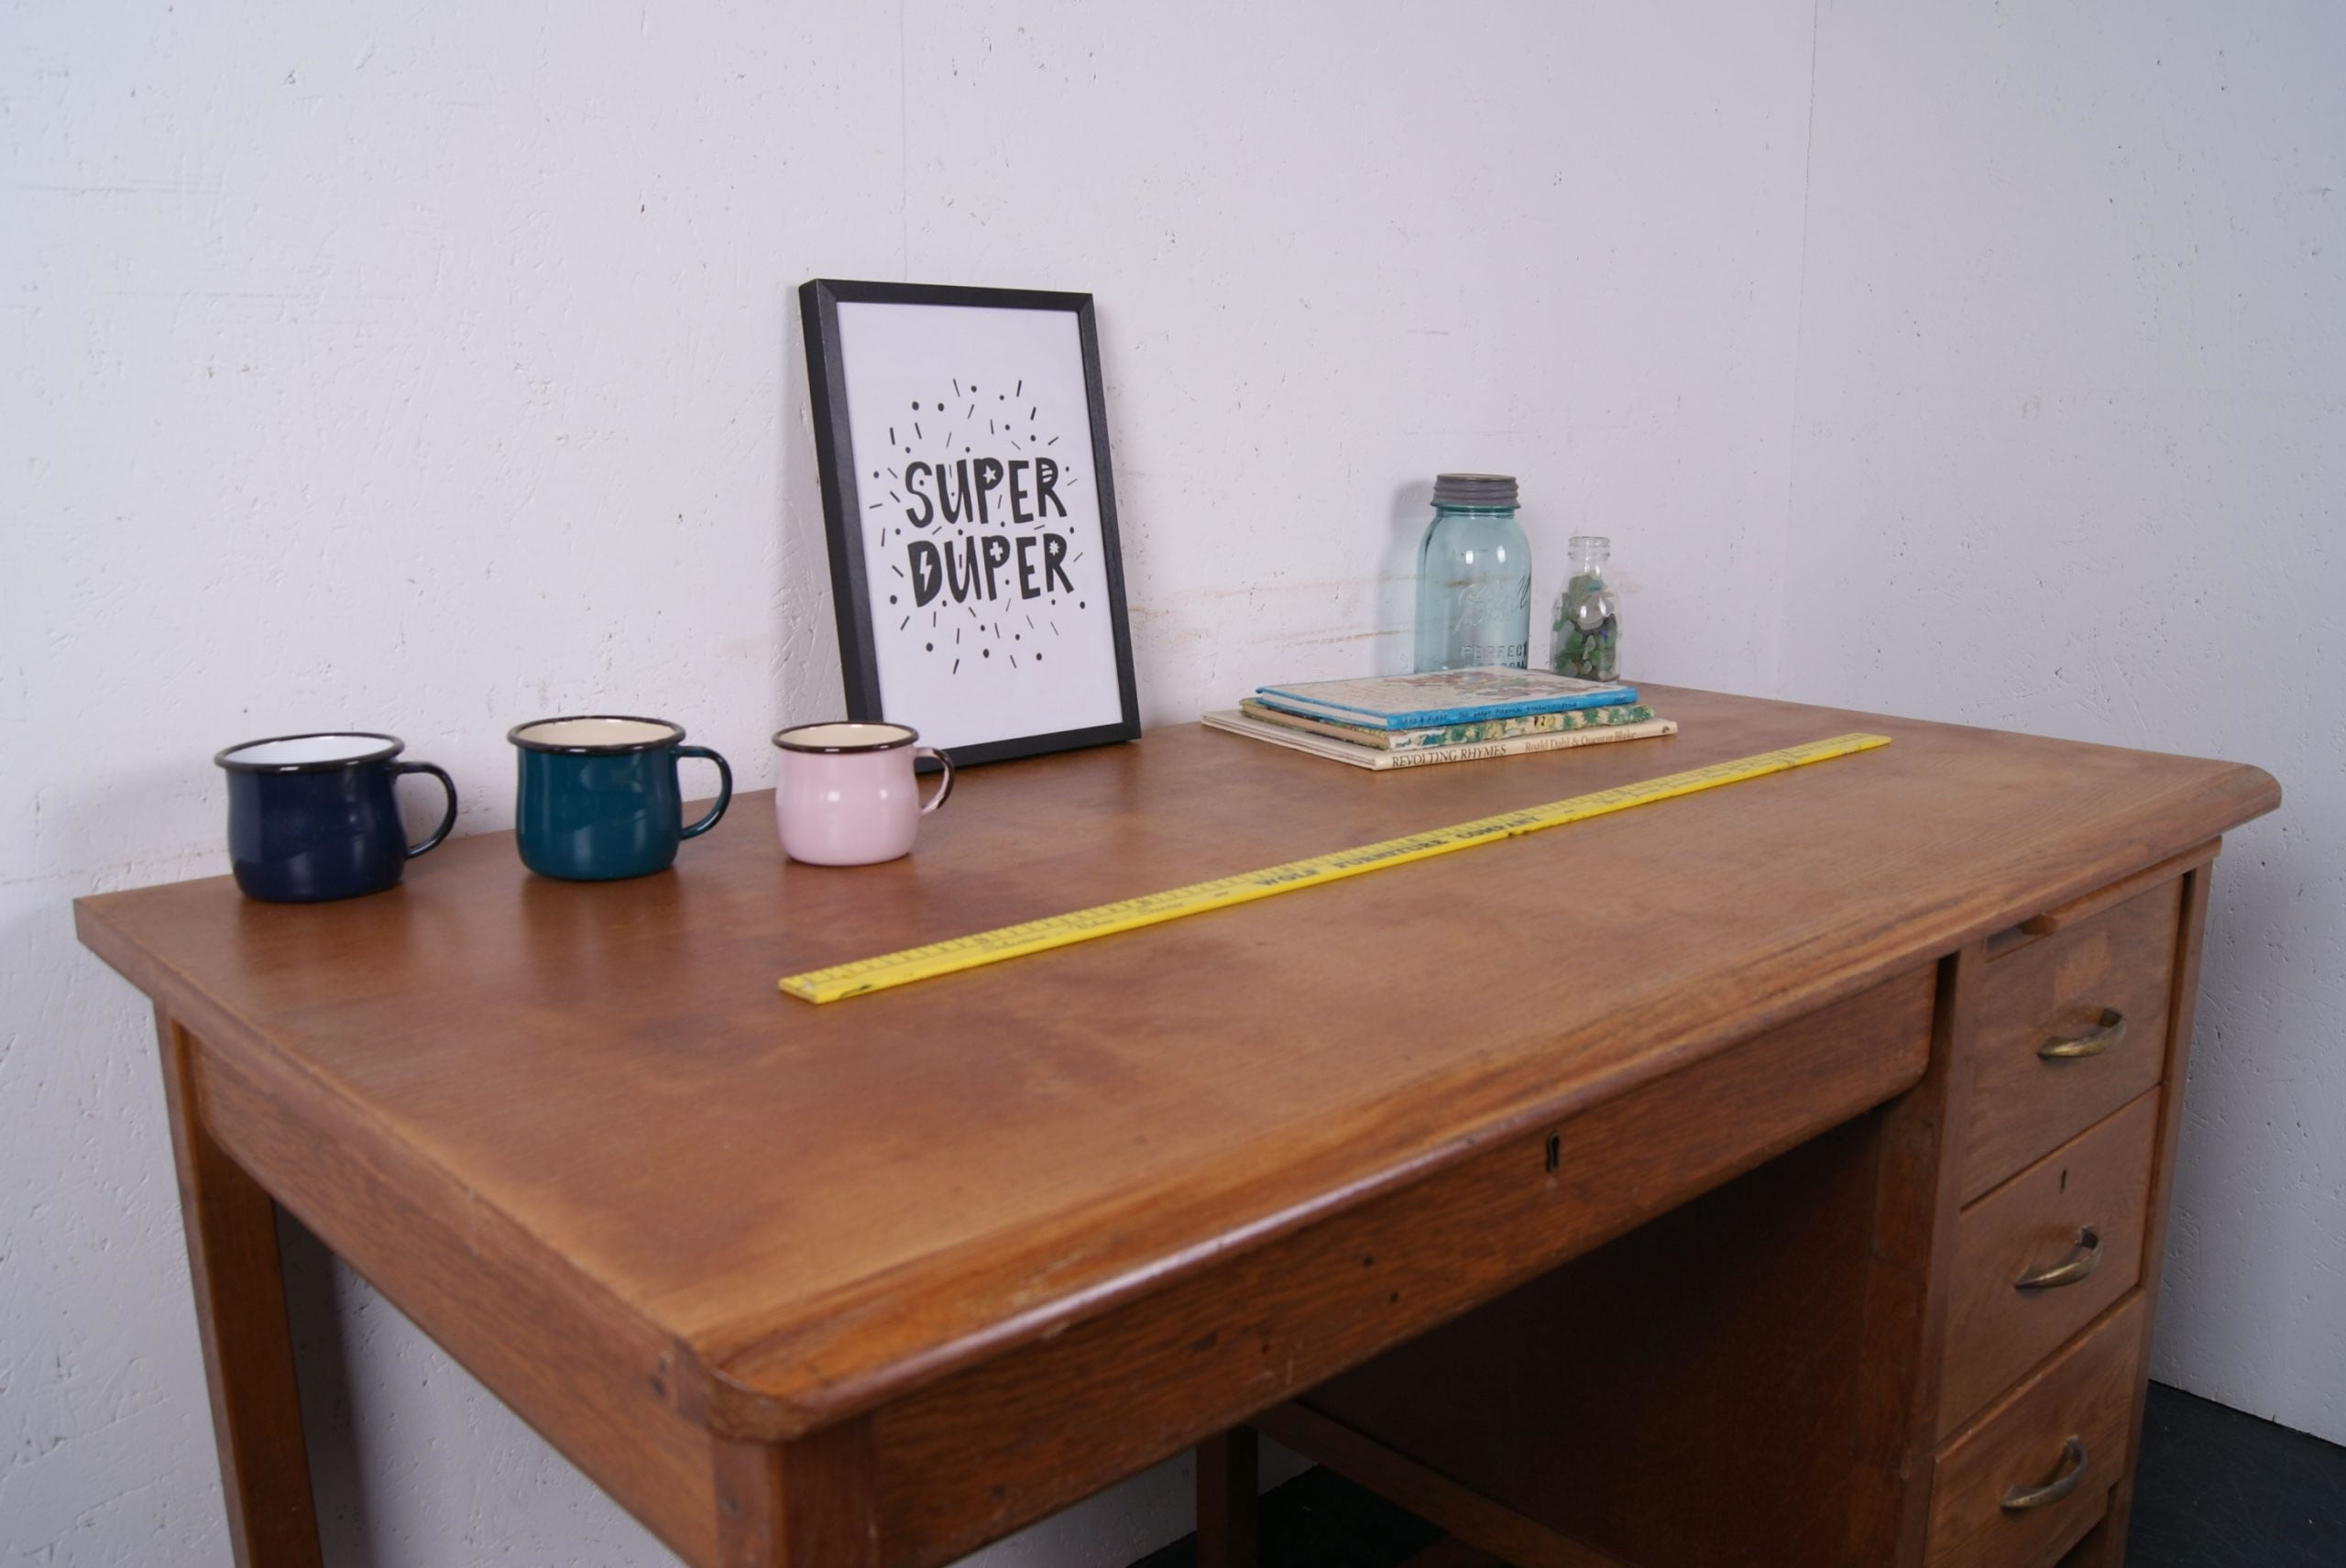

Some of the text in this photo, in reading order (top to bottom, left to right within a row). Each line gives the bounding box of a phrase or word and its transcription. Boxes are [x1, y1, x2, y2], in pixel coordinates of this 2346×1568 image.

[904, 457, 1068, 529] SUPER
[907, 532, 1074, 608] DUPER
[1392, 751, 1457, 768] REVOLTING
[1461, 744, 1507, 761] RHYMES
[1525, 739, 1549, 752] Roald
[1551, 737, 1570, 750] Dahl
[1572, 738, 1579, 748] &
